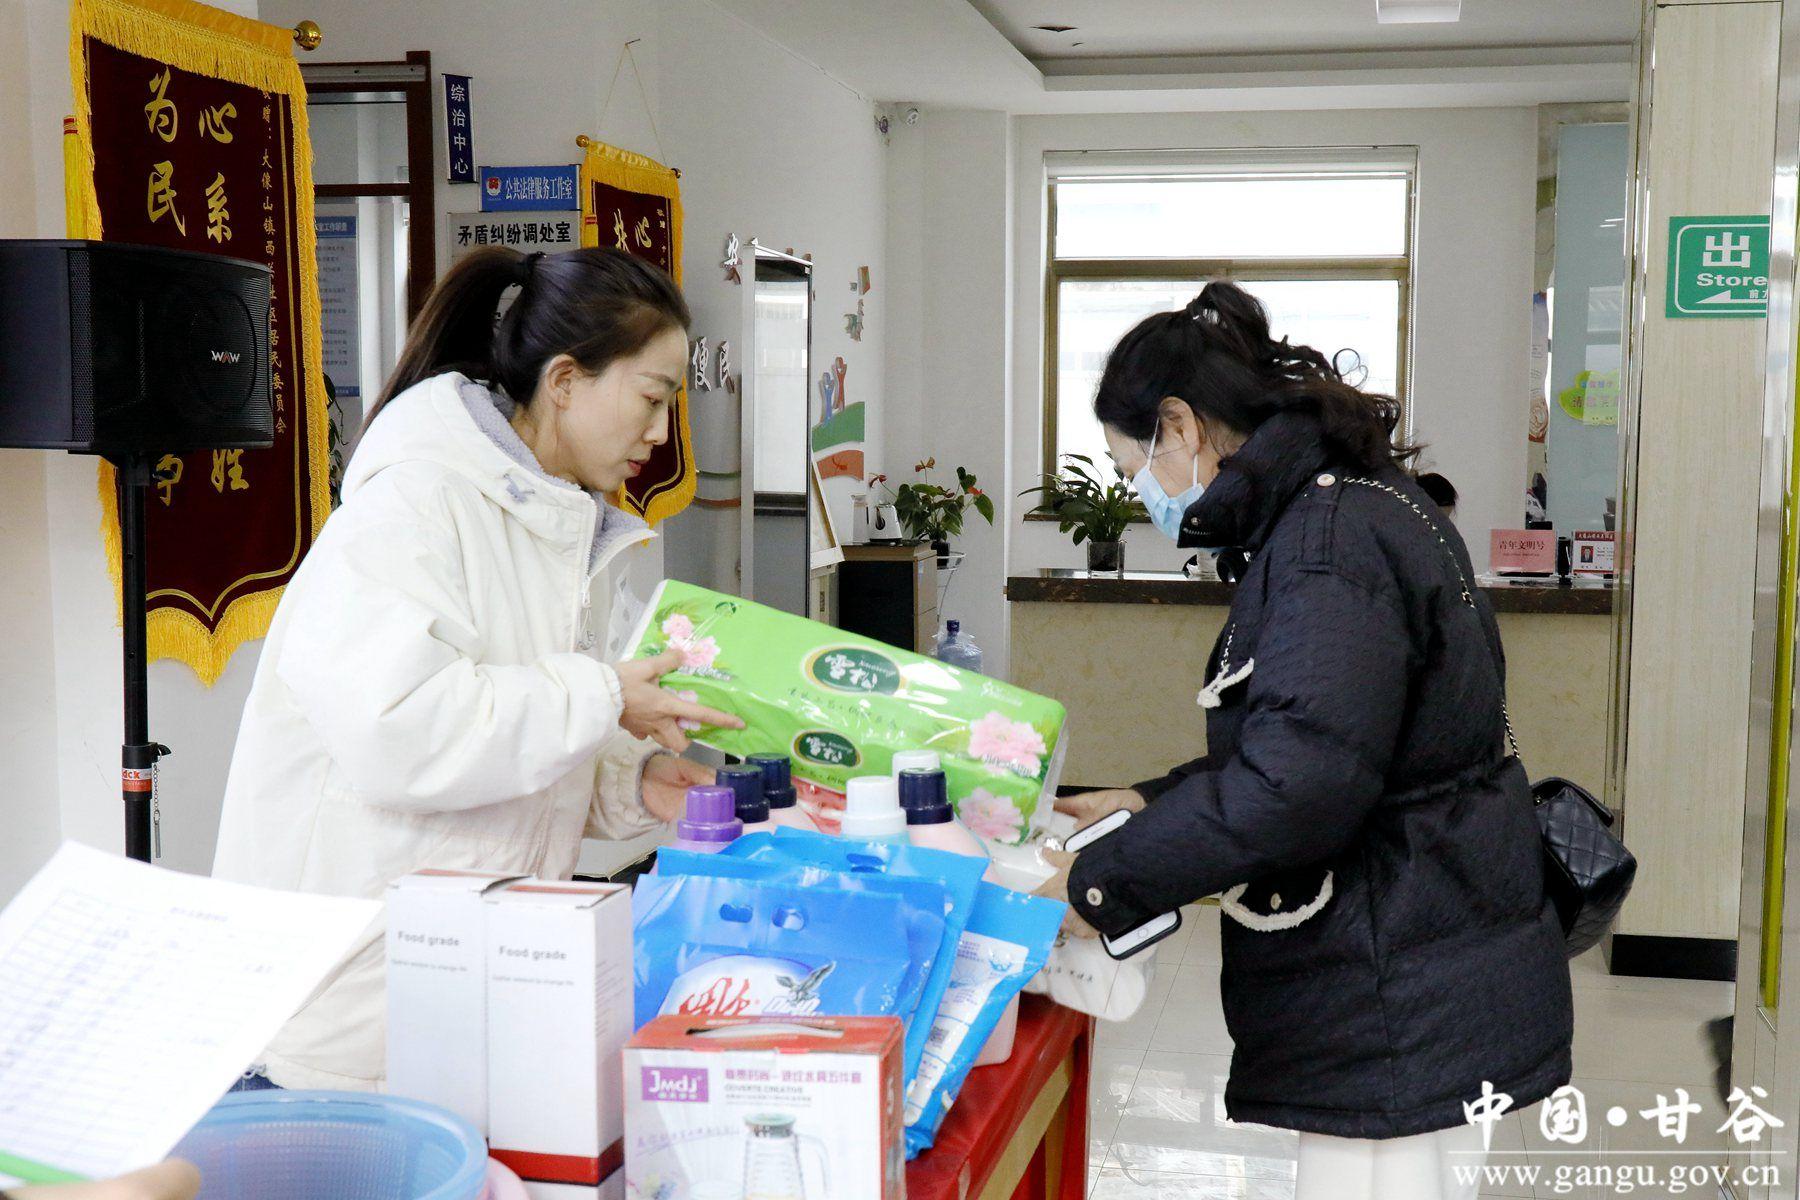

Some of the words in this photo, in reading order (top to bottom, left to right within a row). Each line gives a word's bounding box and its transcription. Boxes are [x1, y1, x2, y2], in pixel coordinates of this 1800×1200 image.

[450, 83, 469, 174] 综治中心
[505, 176, 573, 200] 公共法律服务工作室
[458, 221, 571, 246] 矛盾纠纷调处室
[1703, 231, 1751, 268] 出
[1696, 273, 1768, 287] Store
[398, 930, 425, 943] Food
[427, 934, 460, 947] grade
[498, 945, 529, 958] Food
[532, 949, 567, 962] grade
